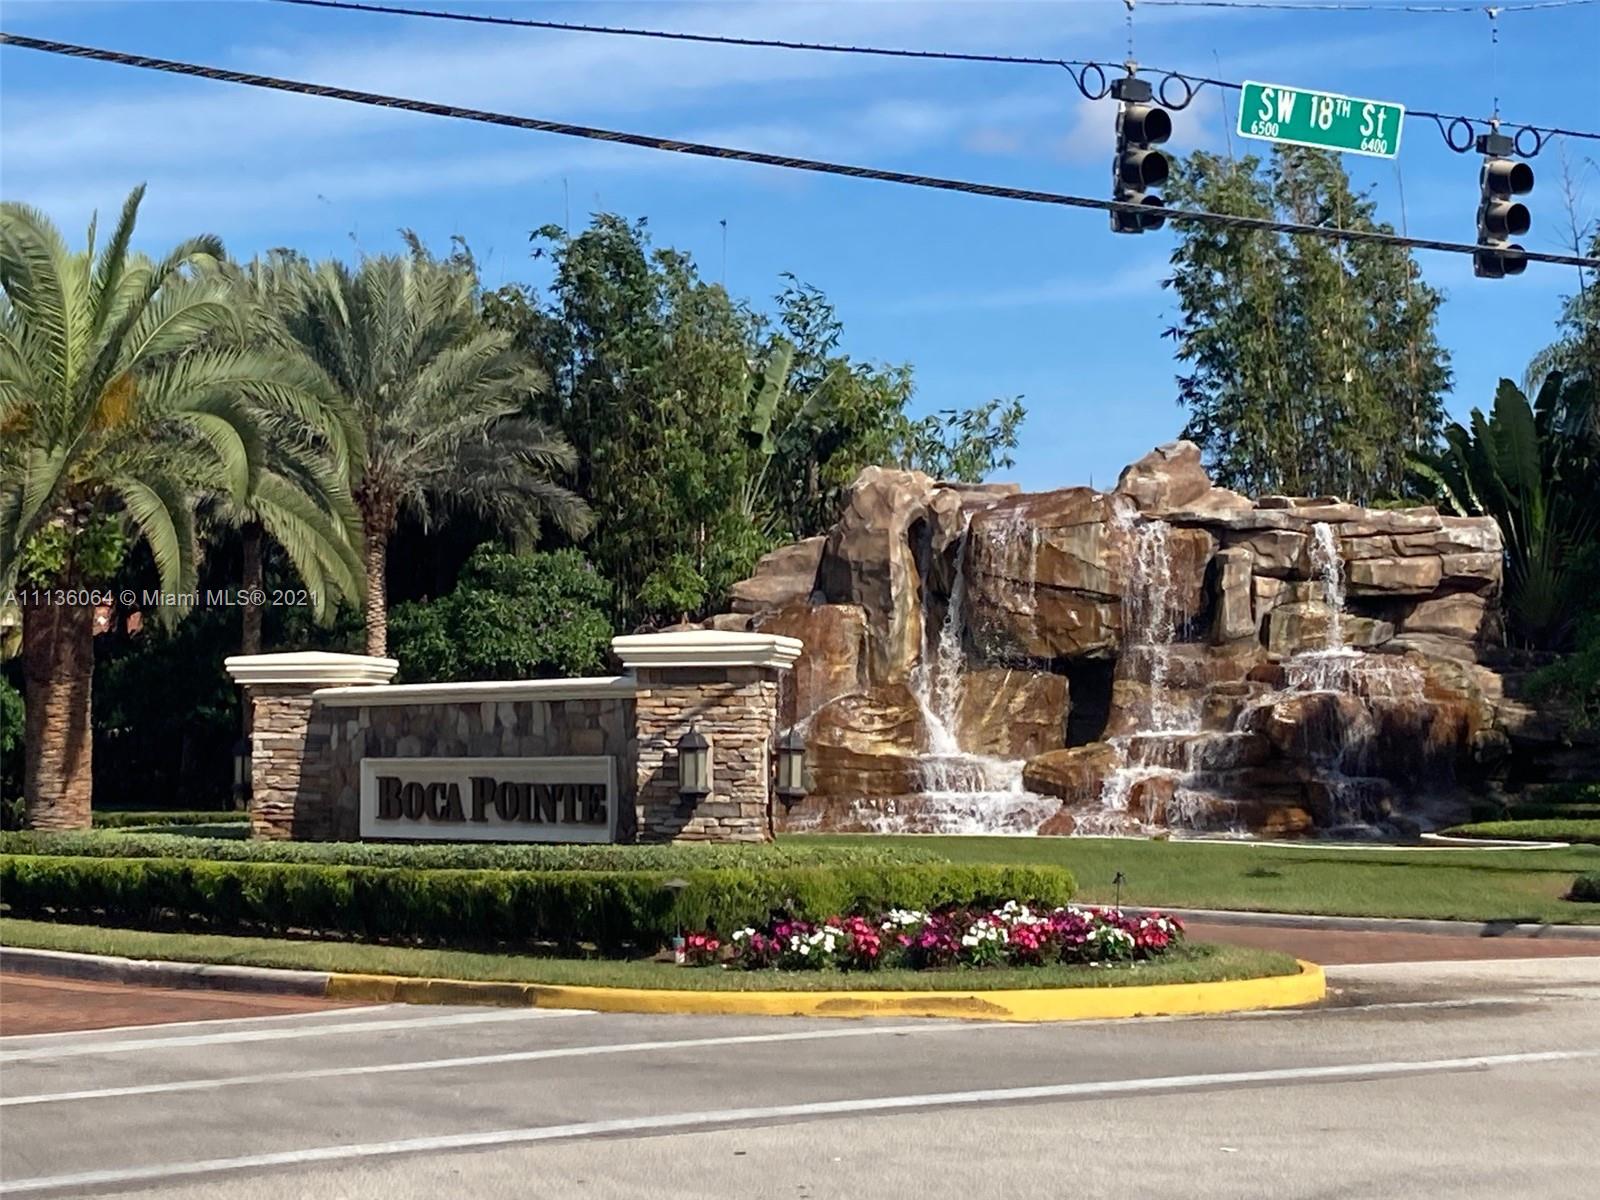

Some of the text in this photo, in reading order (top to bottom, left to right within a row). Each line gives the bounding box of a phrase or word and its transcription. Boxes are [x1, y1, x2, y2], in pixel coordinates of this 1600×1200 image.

[1250, 120, 1280, 137] 6500
[1258, 87, 1388, 138] SW 18TH St
[1360, 137, 1388, 154] 6400
[375, 775, 607, 824] BOCA POINTE
